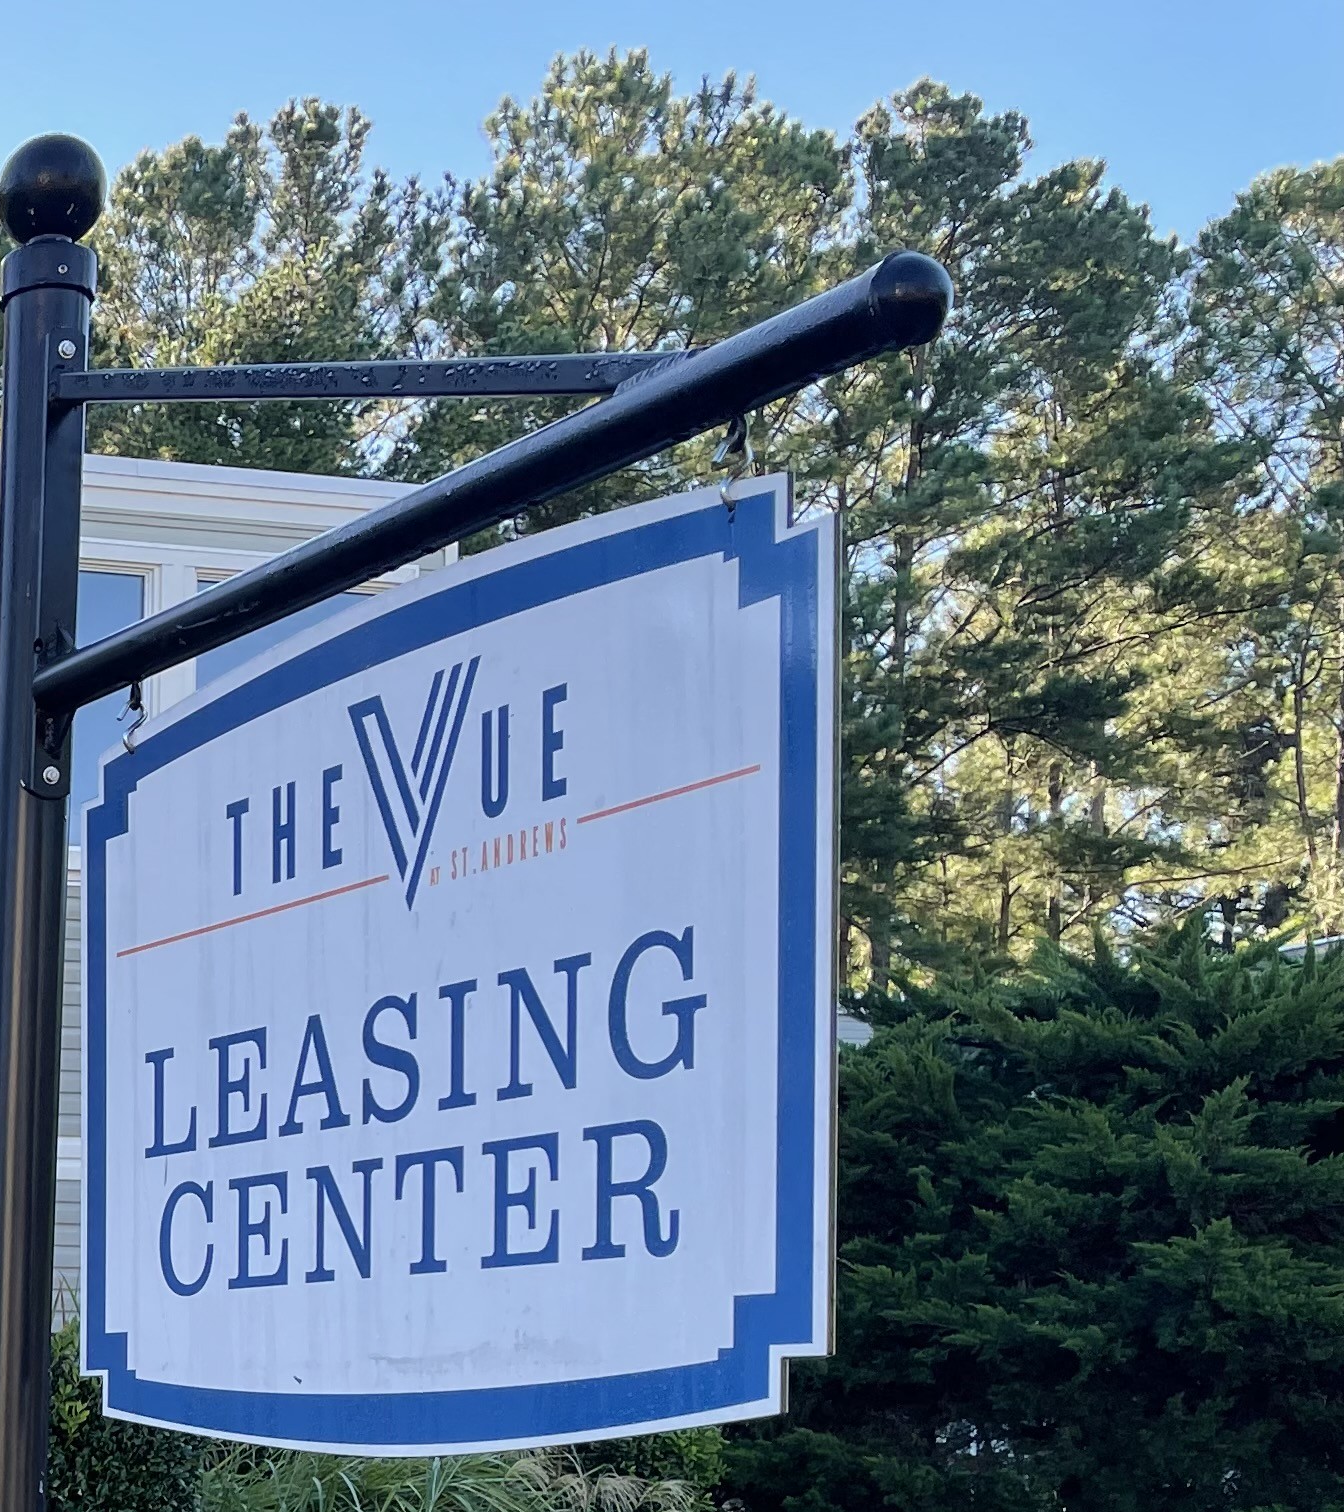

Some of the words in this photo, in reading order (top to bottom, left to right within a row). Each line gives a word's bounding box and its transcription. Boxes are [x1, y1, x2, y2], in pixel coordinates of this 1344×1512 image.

[226, 763, 343, 896] THE
[347, 655, 568, 912] VUE
[430, 866, 441, 886] AT
[145, 925, 708, 1160] LEASING
[158, 1119, 681, 1297] CENTER
